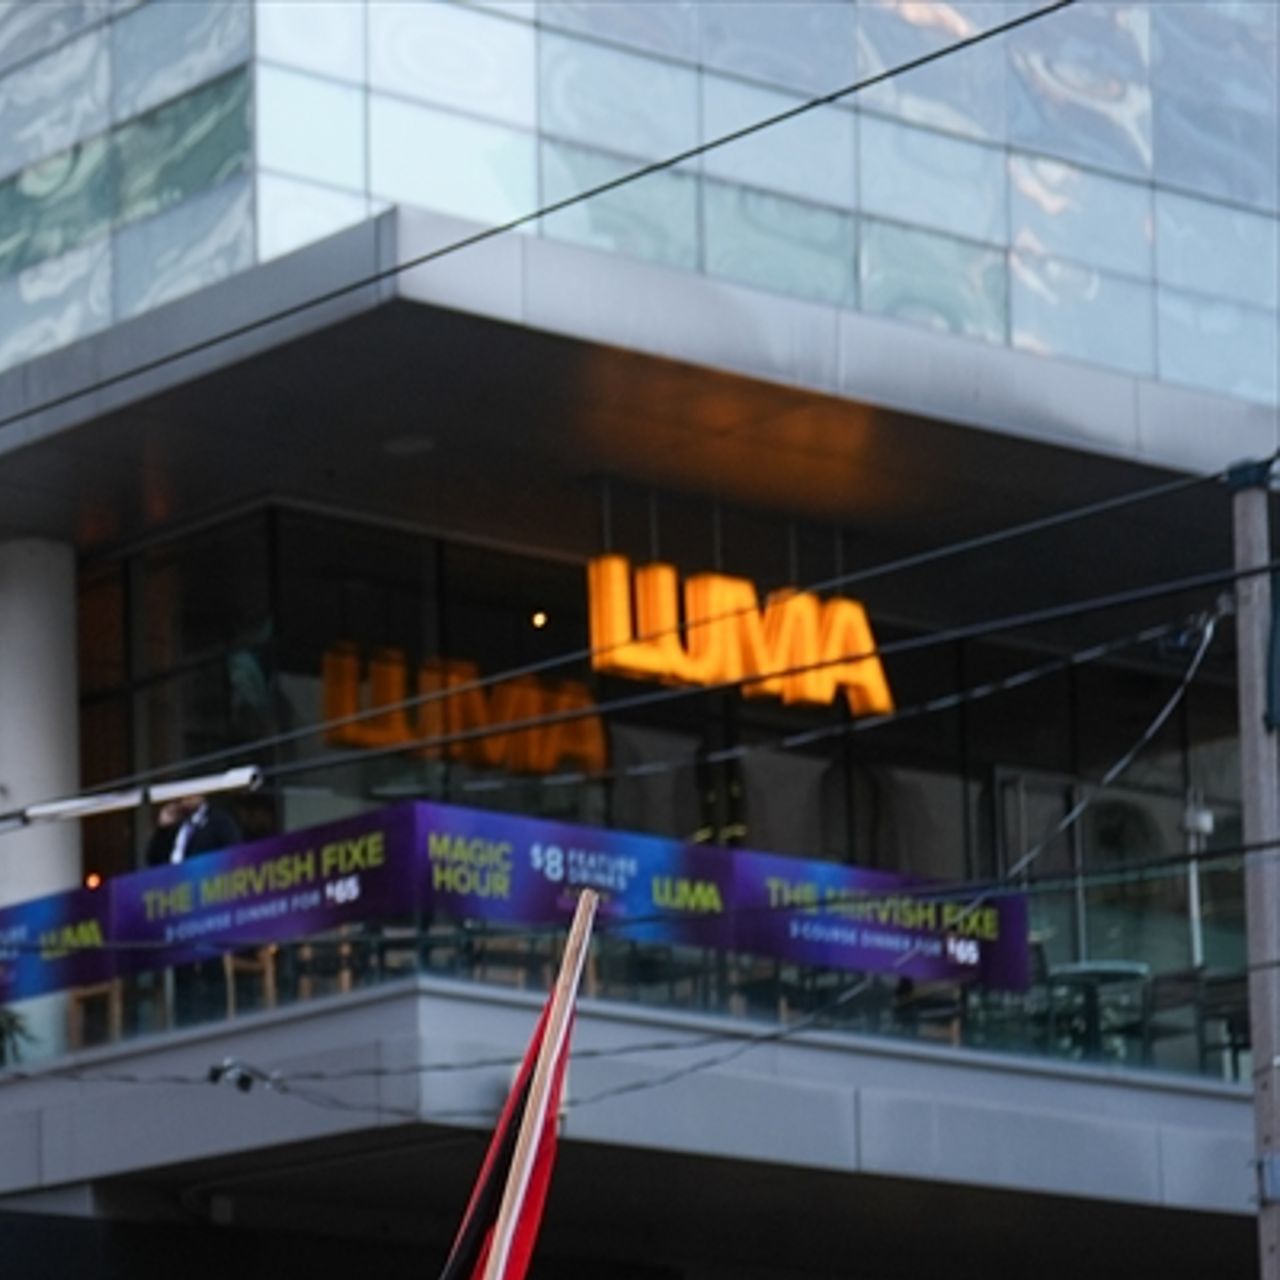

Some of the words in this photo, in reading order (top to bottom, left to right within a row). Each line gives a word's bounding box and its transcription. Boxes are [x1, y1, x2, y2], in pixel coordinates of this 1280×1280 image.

[588, 555, 894, 716] LUMA
[427, 833, 513, 870] MAGIC
[530, 844, 565, 881] $8
[567, 849, 637, 875] FEATURE
[143, 880, 192, 920] THE
[201, 851, 314, 902] MIRVISH
[322, 833, 385, 878] FIXE
[432, 863, 512, 898] HOUR
[651, 876, 723, 913] LUMA
